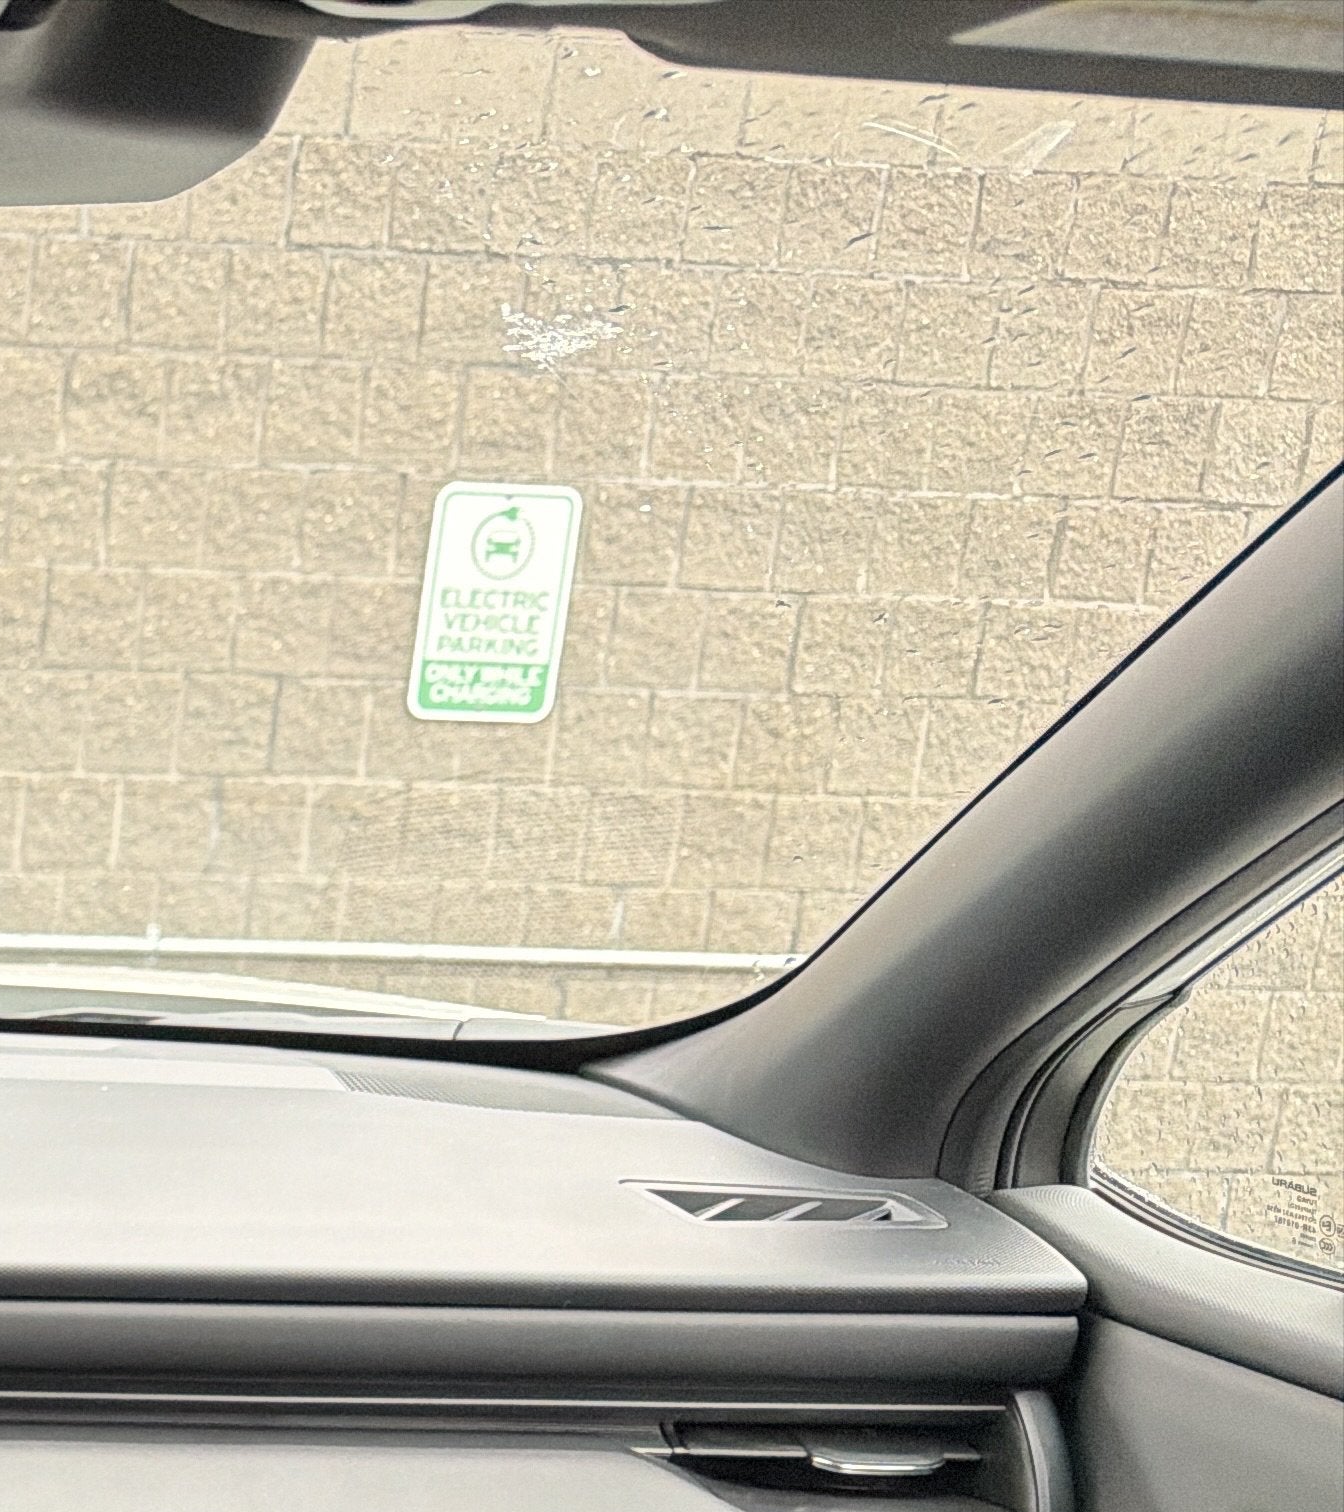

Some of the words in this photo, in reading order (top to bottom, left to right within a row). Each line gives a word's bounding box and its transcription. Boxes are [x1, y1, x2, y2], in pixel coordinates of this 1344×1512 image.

[439, 587, 550, 611] ELECTRIC
[443, 612, 541, 635] VEHICLE
[436, 635, 538, 656] PARKING
